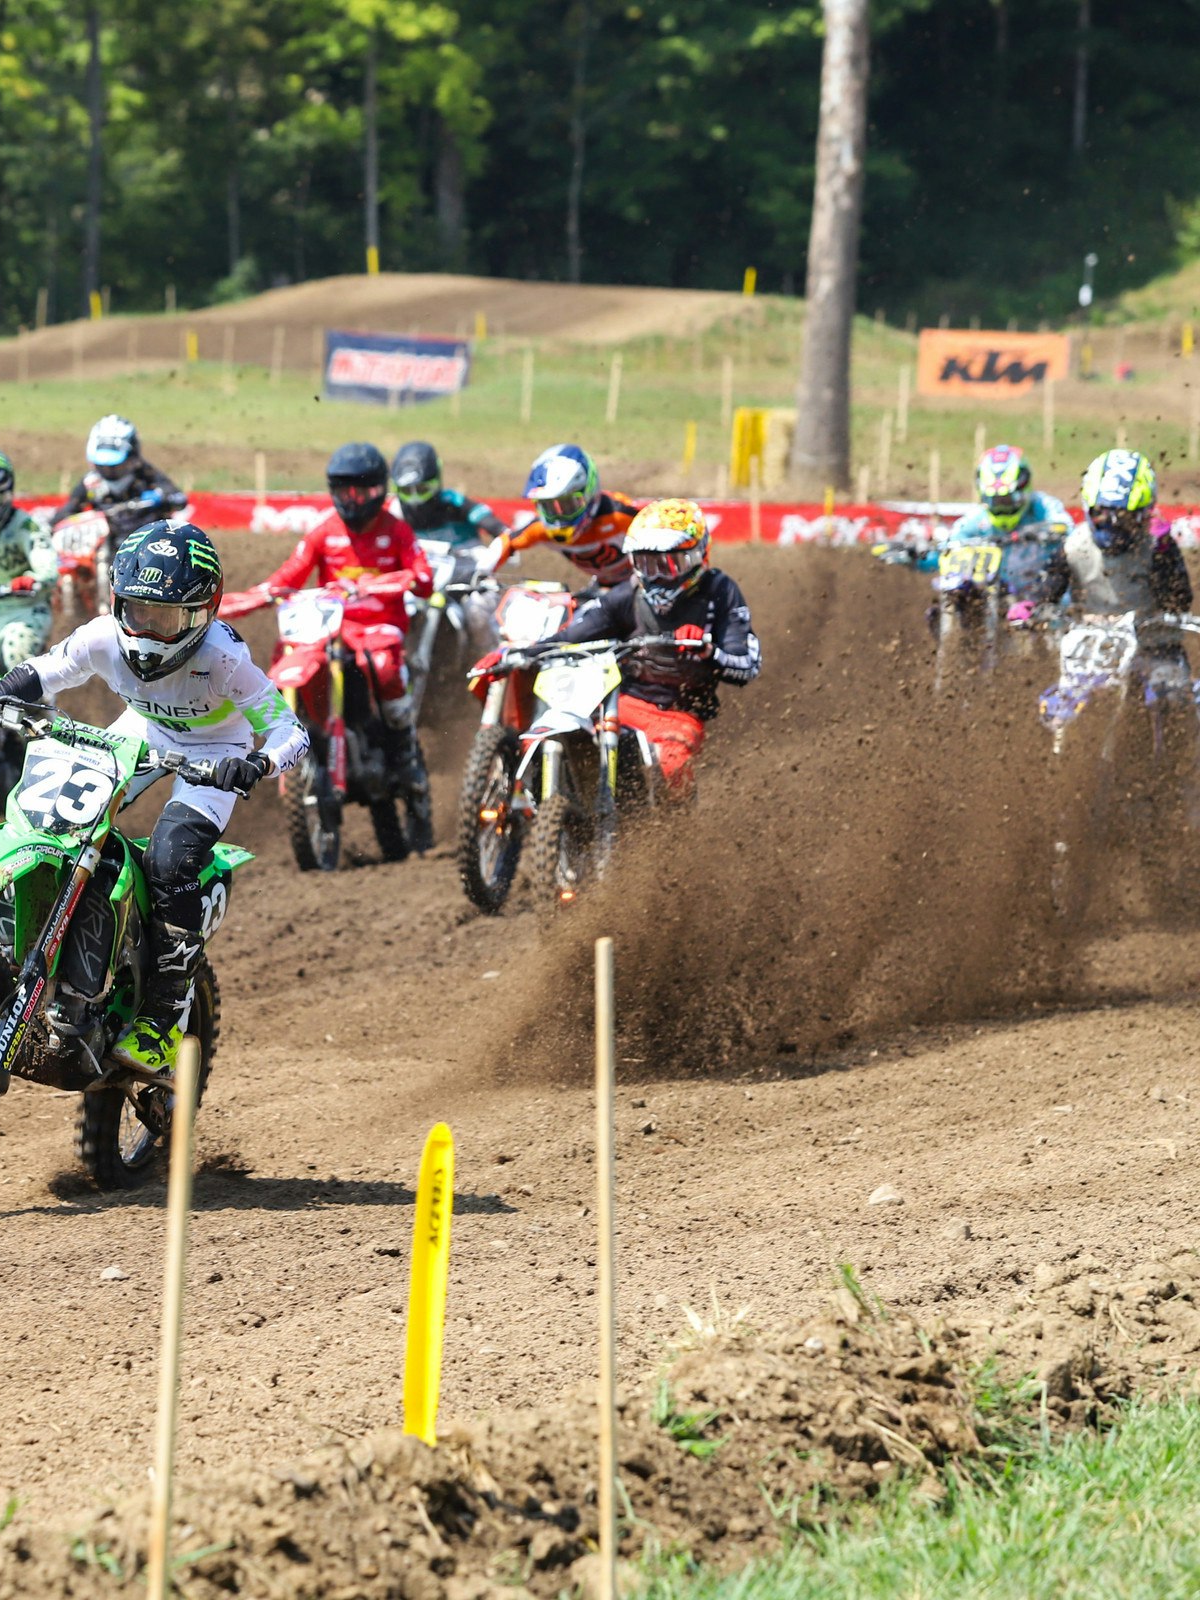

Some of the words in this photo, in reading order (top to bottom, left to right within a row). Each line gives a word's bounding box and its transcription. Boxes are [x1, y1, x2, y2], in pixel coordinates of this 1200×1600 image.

[939, 349, 1048, 384] KTM
[17, 758, 114, 825] 23
[35, 844, 66, 859] CIRCUIT
[23, 977, 45, 1022] BRAKING
[3, 1022, 26, 1070] ACERBIS
